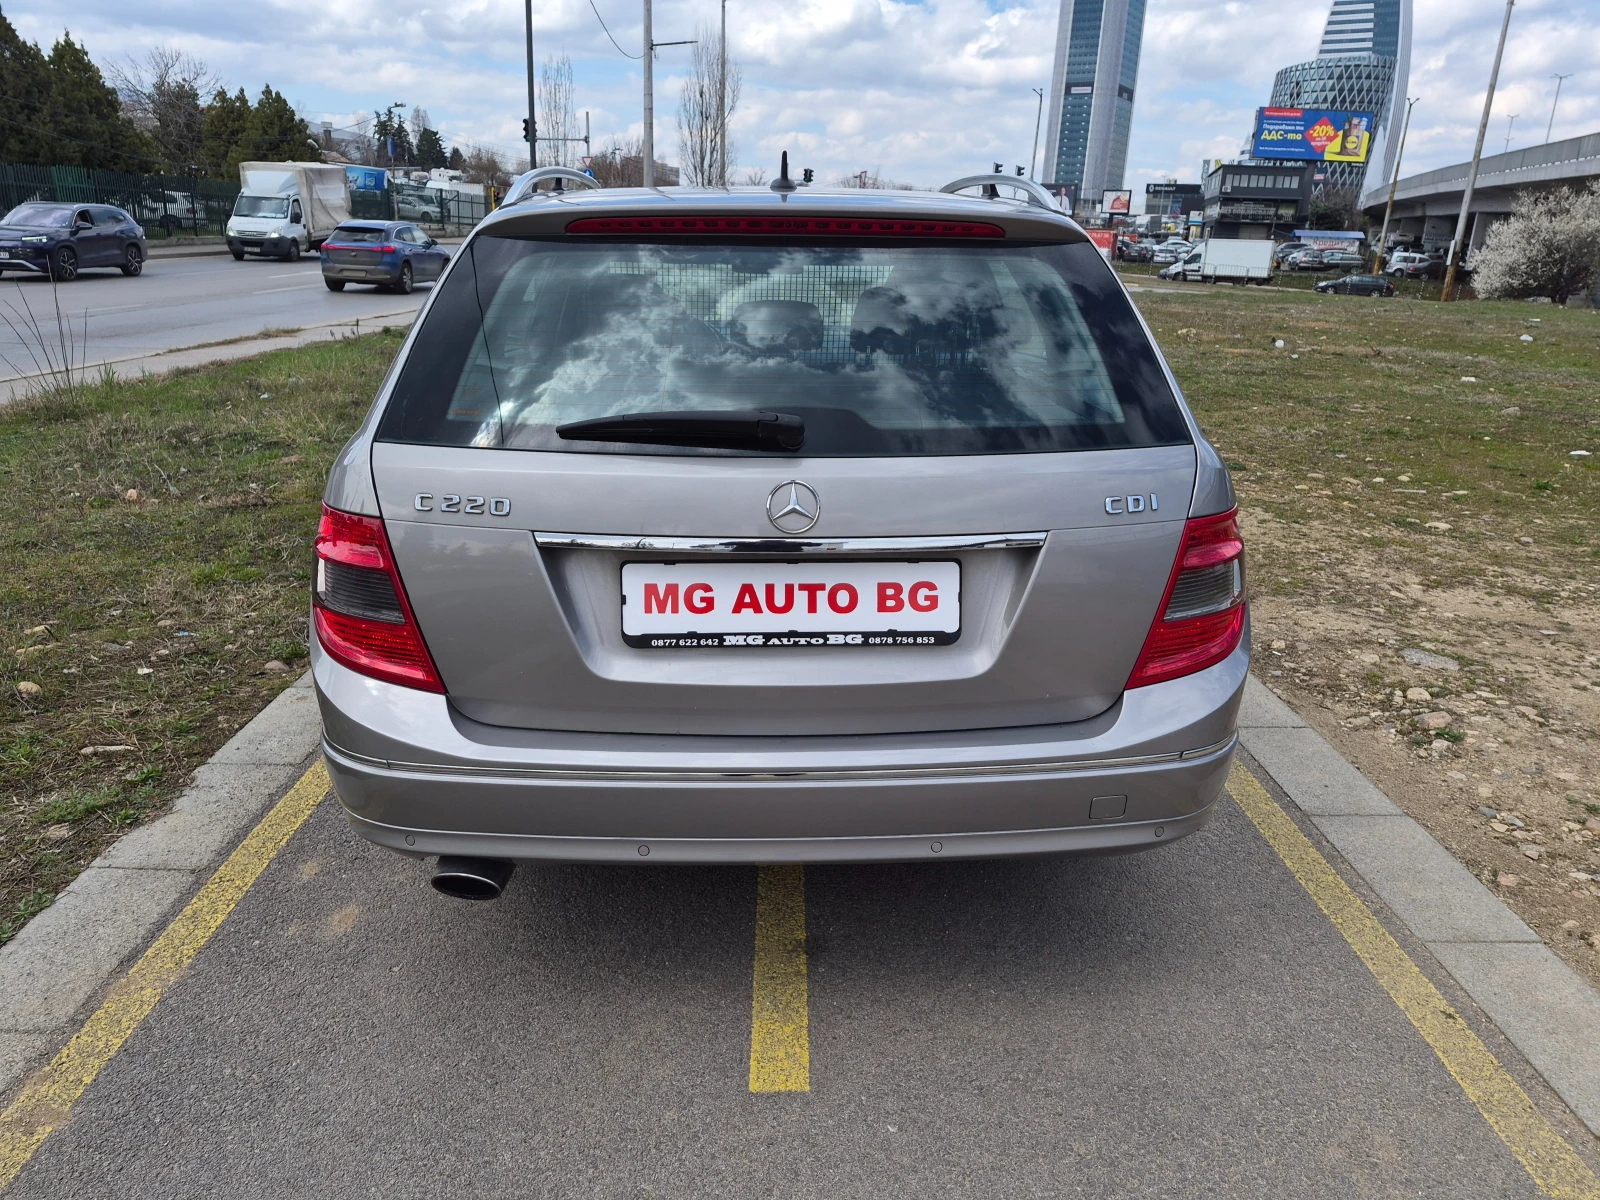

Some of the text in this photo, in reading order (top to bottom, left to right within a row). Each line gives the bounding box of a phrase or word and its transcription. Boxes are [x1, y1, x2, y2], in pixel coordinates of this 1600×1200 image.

[1310, 126, 1334, 137] -20%
[1312, 238, 1344, 247] Кредит
[414, 493, 512, 516] C 220
[1104, 492, 1159, 514] CDI
[643, 581, 939, 614] MG AUTO BG
[678, 638, 698, 646] 622
[700, 638, 720, 646] 642
[722, 634, 765, 646] MG
[826, 634, 864, 644] BG
[868, 636, 895, 644] 0878
